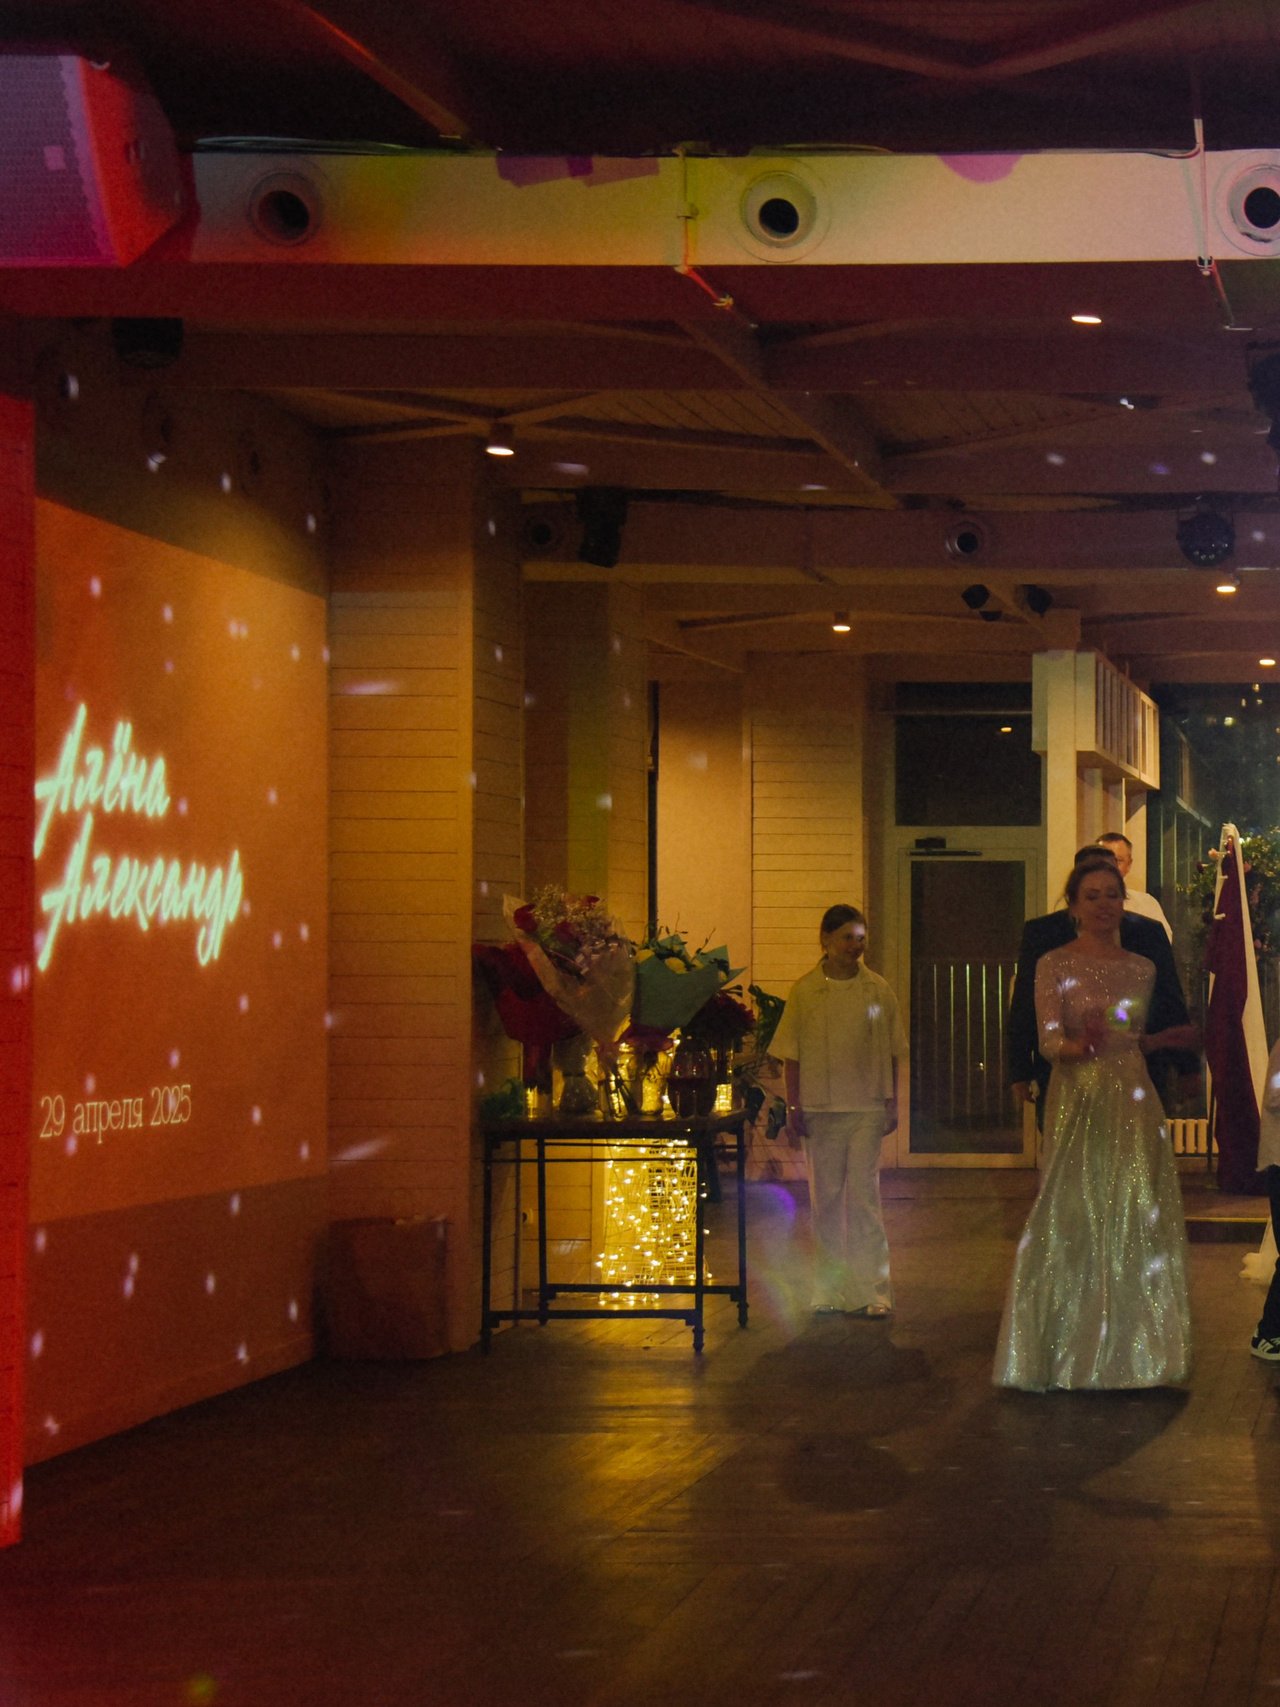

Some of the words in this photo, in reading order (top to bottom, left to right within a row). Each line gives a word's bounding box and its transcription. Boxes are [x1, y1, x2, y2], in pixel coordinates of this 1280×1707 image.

[34, 703, 170, 859] Алёна
[37, 811, 243, 971] Александр
[40, 1095, 65, 1138] 29
[73, 1098, 143, 1144] апреля
[150, 1084, 192, 1126] 2025
